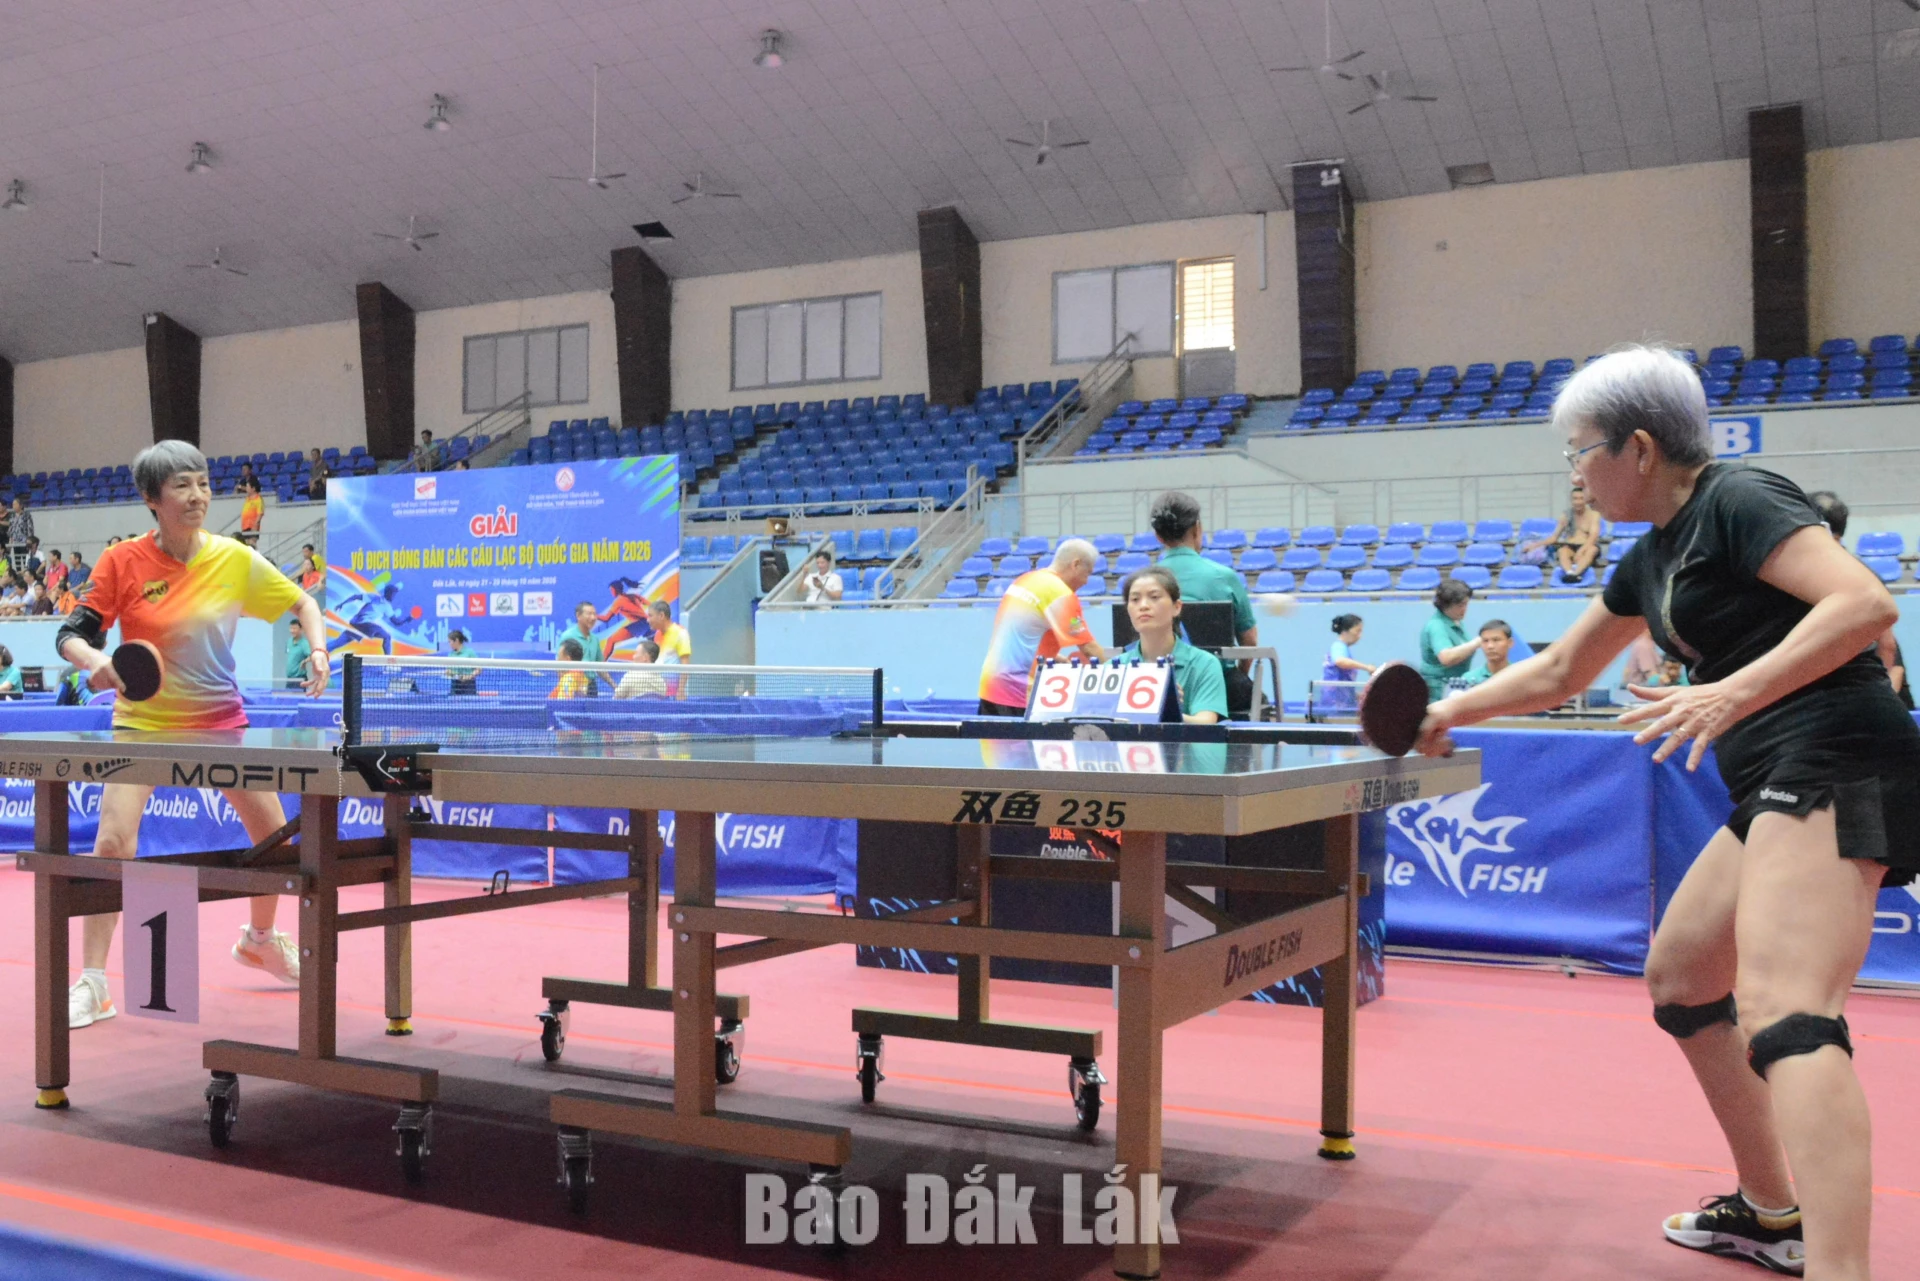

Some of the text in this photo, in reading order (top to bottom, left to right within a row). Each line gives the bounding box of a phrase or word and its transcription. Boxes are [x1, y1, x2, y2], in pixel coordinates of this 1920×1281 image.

[1711, 421, 1752, 455] B
[470, 505, 518, 538] GIẢI
[366, 549, 391, 574] ĐỊCH
[393, 545, 421, 570] BÓNG
[423, 543, 446, 569] BÀN
[447, 543, 469, 568] CÁC
[471, 542, 493, 567] CÂU
[495, 545, 516, 570] LẠC
[519, 541, 534, 569] BỘ
[537, 536, 567, 566] QUỐC
[570, 542, 590, 563] GIA
[592, 537, 620, 562] NĂM
[623, 540, 652, 562] 2026
[1040, 676, 1071, 708] 3
[1126, 675, 1159, 709] 6
[19, 762, 42, 777] FISH
[172, 762, 320, 791] MOFIT
[144, 794, 198, 819] Double
[342, 798, 494, 828] Dou FISH
[952, 790, 1127, 828] 双鱼 235
[729, 824, 785, 849] FISH
[1040, 843, 1088, 859] Double
[1468, 864, 1548, 893] FISH
[140, 911, 176, 1013] 1
[1224, 927, 1303, 988] DOUBLE FISH
